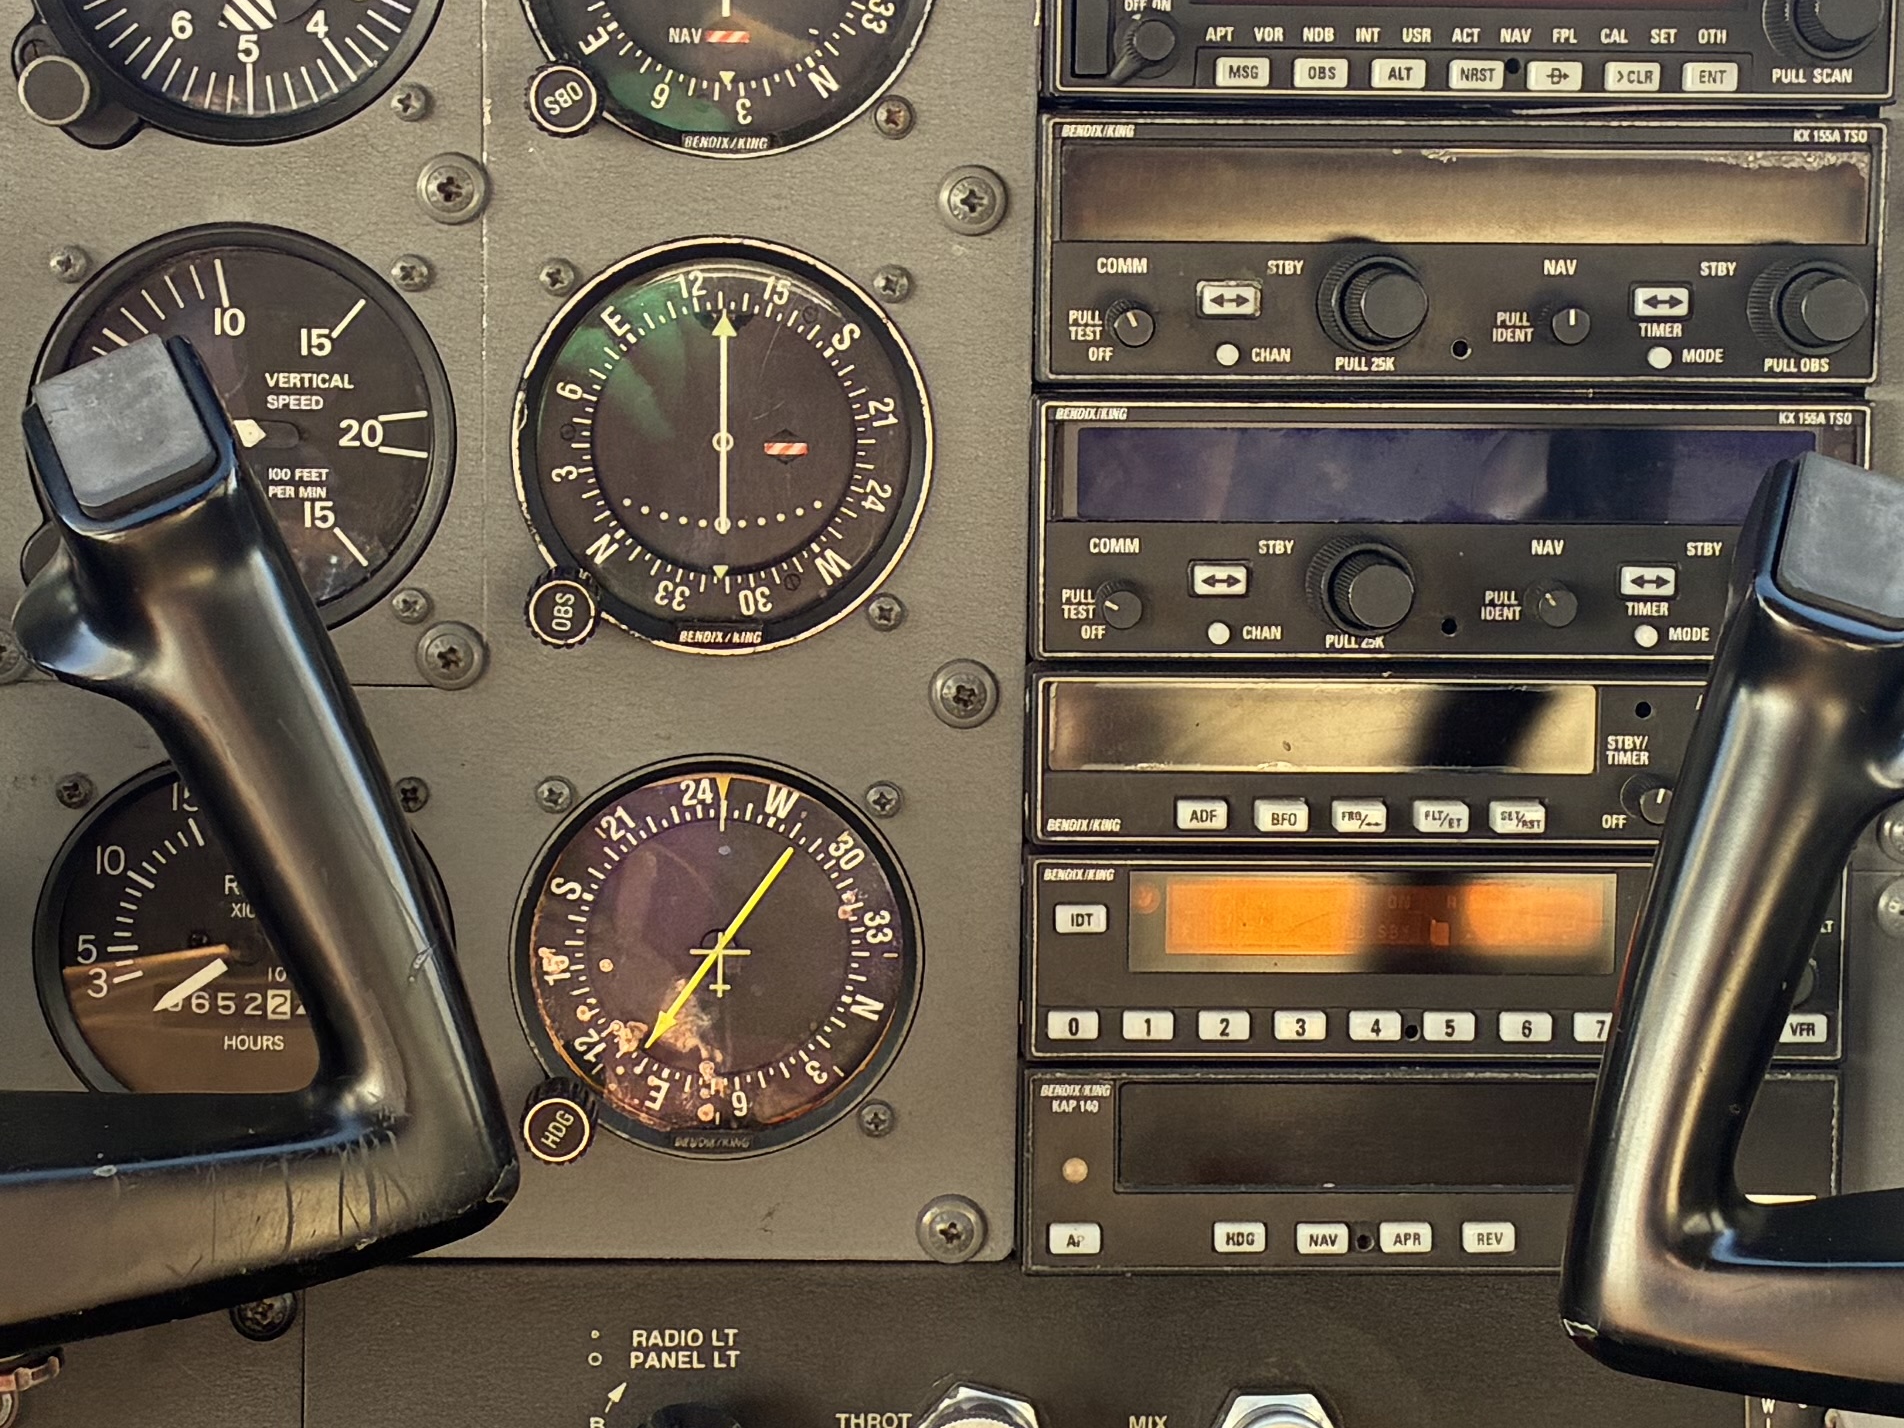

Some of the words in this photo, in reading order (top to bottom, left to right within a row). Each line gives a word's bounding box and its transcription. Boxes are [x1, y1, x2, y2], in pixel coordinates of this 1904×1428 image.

[1205, 26, 1235, 42] APT
[1253, 26, 1284, 43] VOR
[1302, 26, 1335, 43] NDB
[1451, 27, 1482, 44] ACT
[1552, 27, 1578, 44] FPL
[1228, 64, 1259, 80] MSG
[1387, 65, 1414, 82] ALT
[1771, 67, 1808, 84] PULL
[1812, 67, 1853, 84] SCAN
[1096, 256, 1148, 275] COMM
[1543, 258, 1578, 276] NAV
[1251, 347, 1292, 363] CHAN
[1681, 348, 1724, 364] MODE
[264, 372, 355, 390] VERTICAL
[266, 394, 324, 410] SPEED
[338, 418, 383, 448] 20
[1189, 808, 1218, 824] ADF
[1070, 912, 1094, 928] IDT
[1392, 1231, 1422, 1247] APR
[1476, 1231, 1504, 1247] REV
[632, 1328, 704, 1348] RADIO
[711, 1328, 739, 1347] LT
[629, 1350, 706, 1370] PANEL
[713, 1349, 741, 1369] LT
